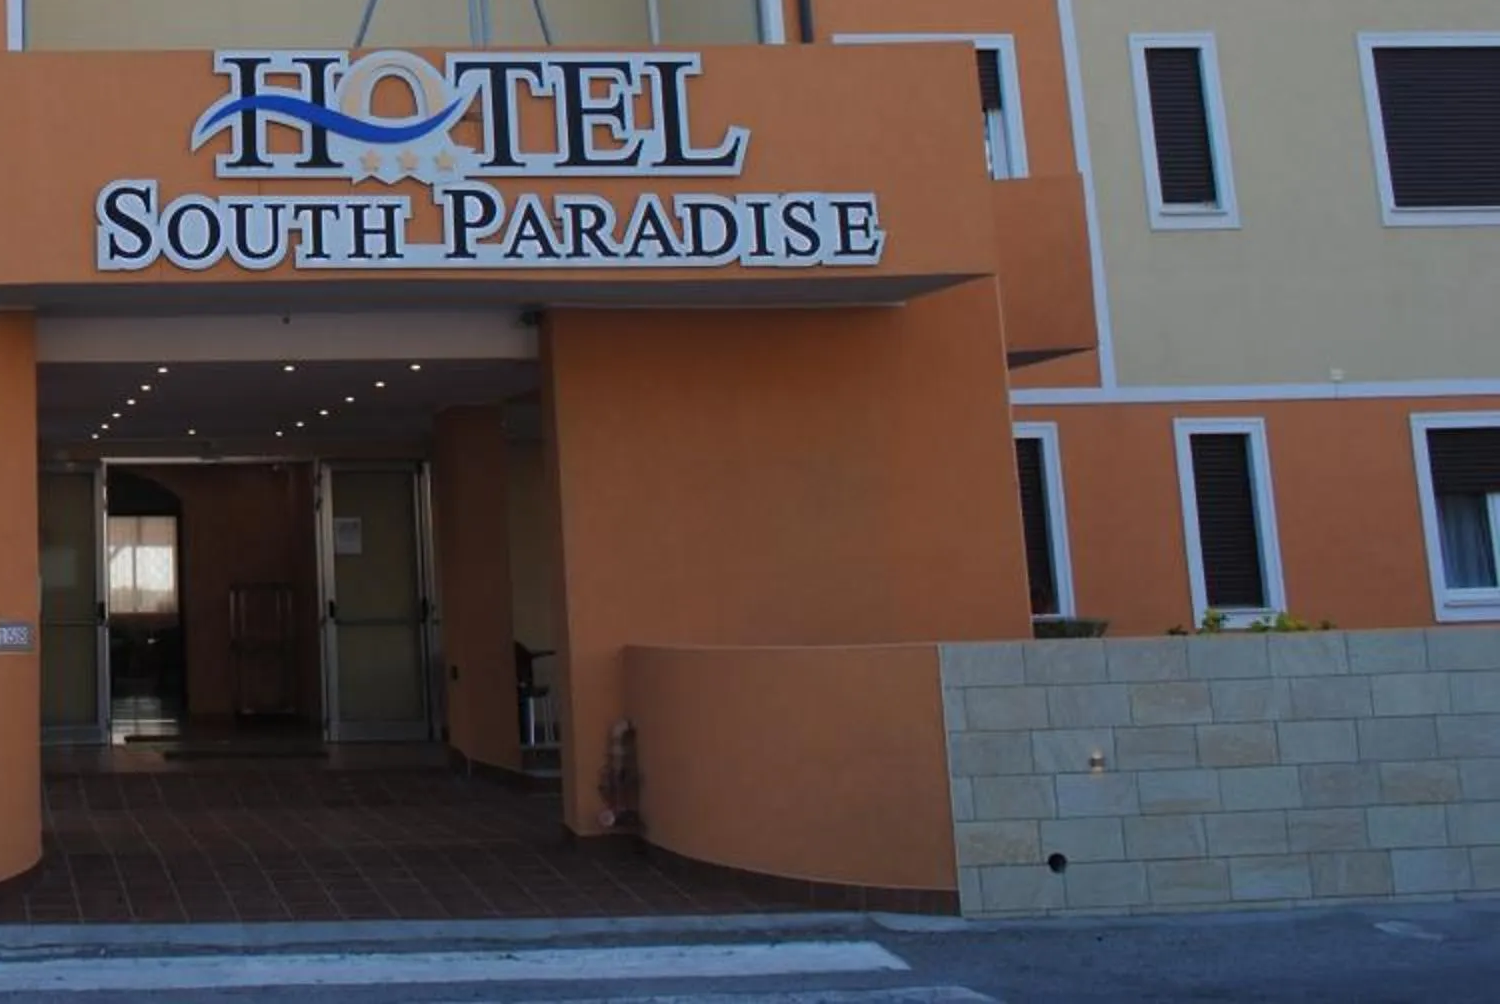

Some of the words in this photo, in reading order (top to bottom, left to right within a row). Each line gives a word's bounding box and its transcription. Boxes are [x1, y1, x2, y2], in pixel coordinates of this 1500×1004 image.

[217, 51, 745, 169] HOTEL
[102, 187, 406, 264] SOUTH
[443, 188, 880, 264] PARADISE
